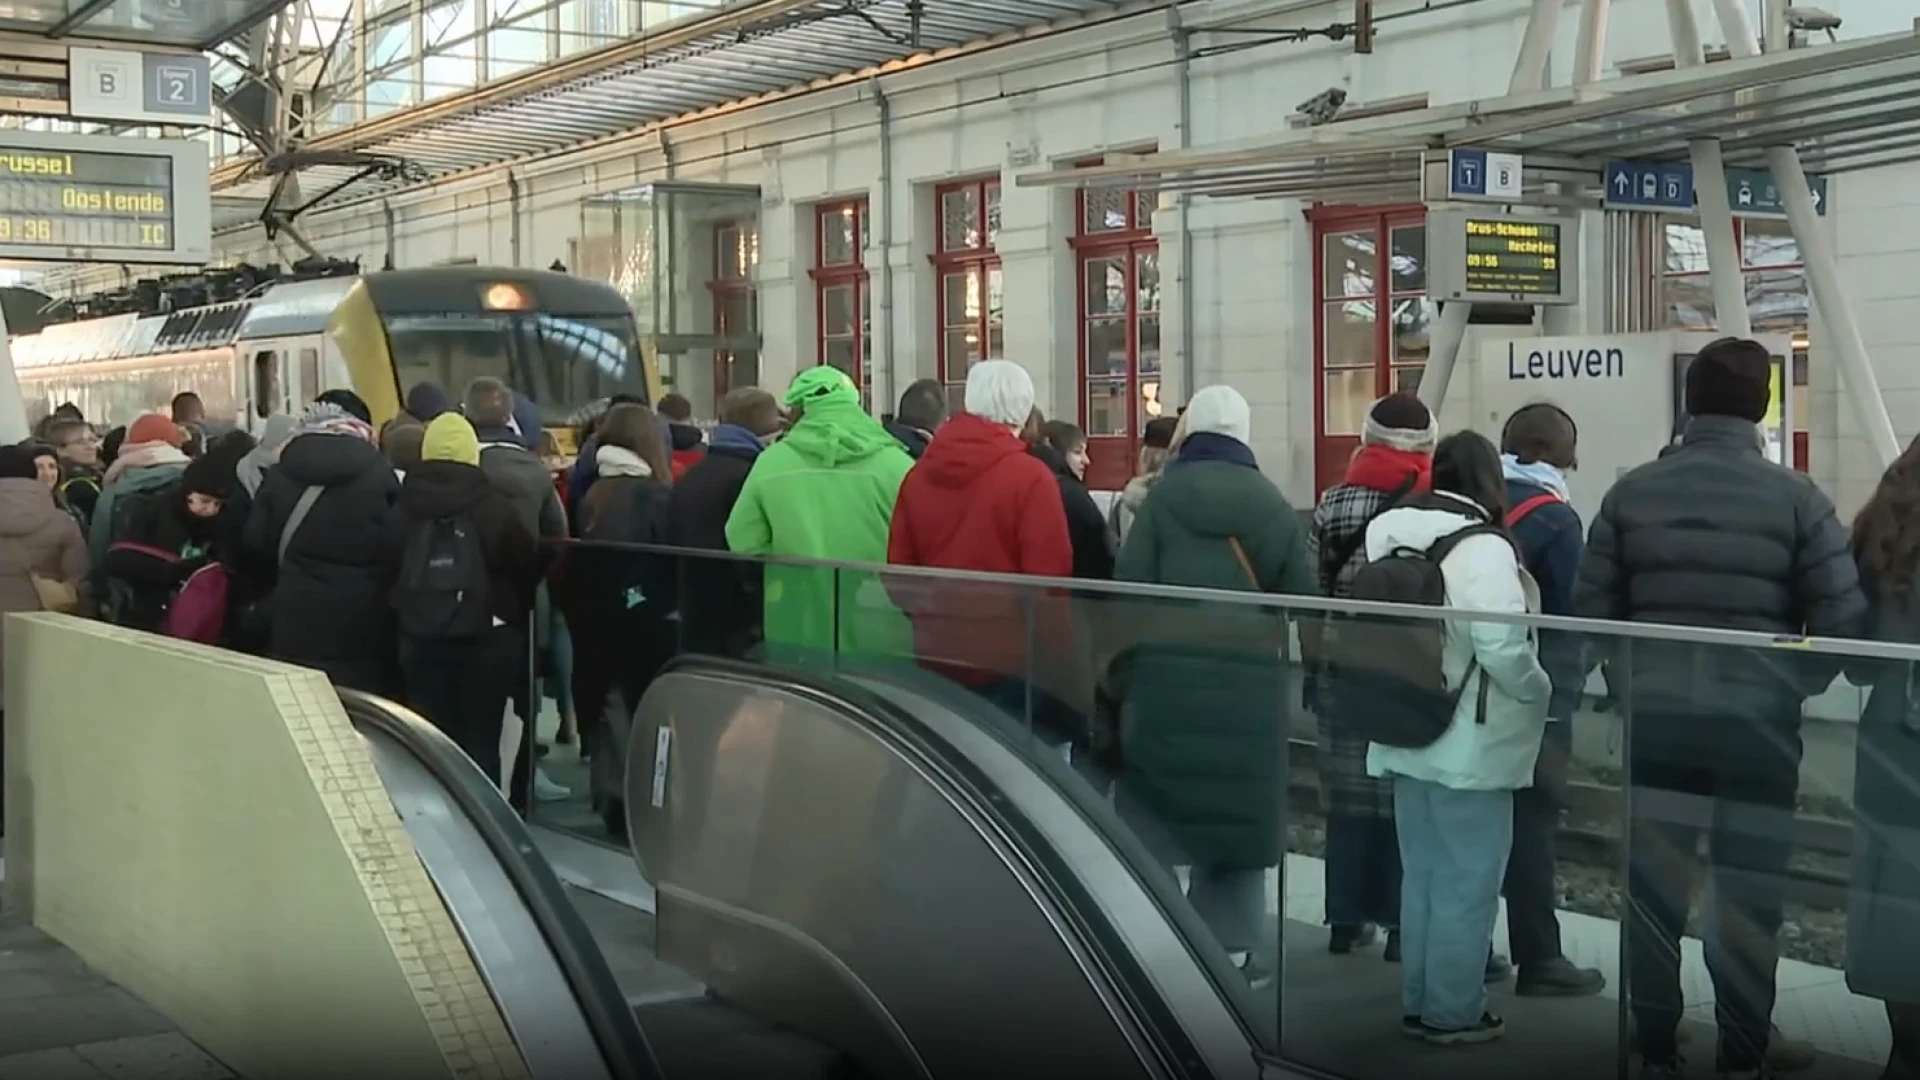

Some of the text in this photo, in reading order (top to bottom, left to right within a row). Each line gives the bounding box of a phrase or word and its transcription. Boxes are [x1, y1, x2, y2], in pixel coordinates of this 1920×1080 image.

[100, 73, 115, 93] B
[170, 79, 184, 101] 2
[1466, 170, 1472, 185] 1
[1500, 170, 1509, 185] B
[62, 188, 164, 212] Oostende
[1669, 183, 1677, 198] D
[140, 224, 165, 245] IC
[1509, 342, 1624, 380] Leuven
